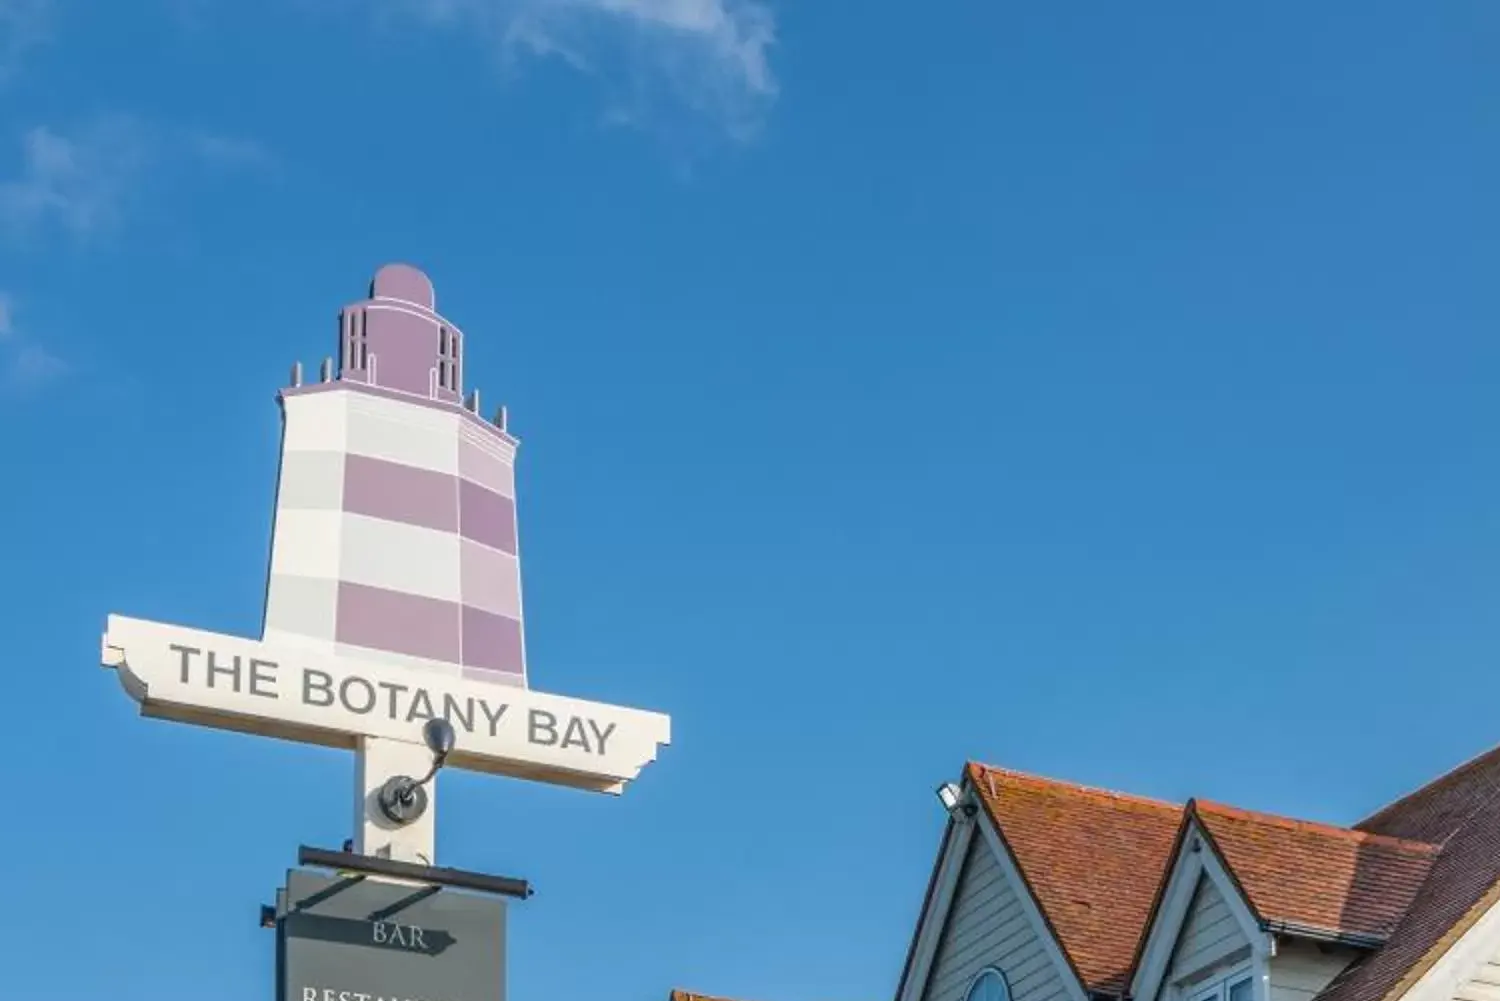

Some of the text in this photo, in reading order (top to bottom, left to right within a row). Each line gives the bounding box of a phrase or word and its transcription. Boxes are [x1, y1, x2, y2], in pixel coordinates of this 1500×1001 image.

[169, 644, 617, 756] THE BOTANY BAY
[373, 921, 430, 949] BAR
